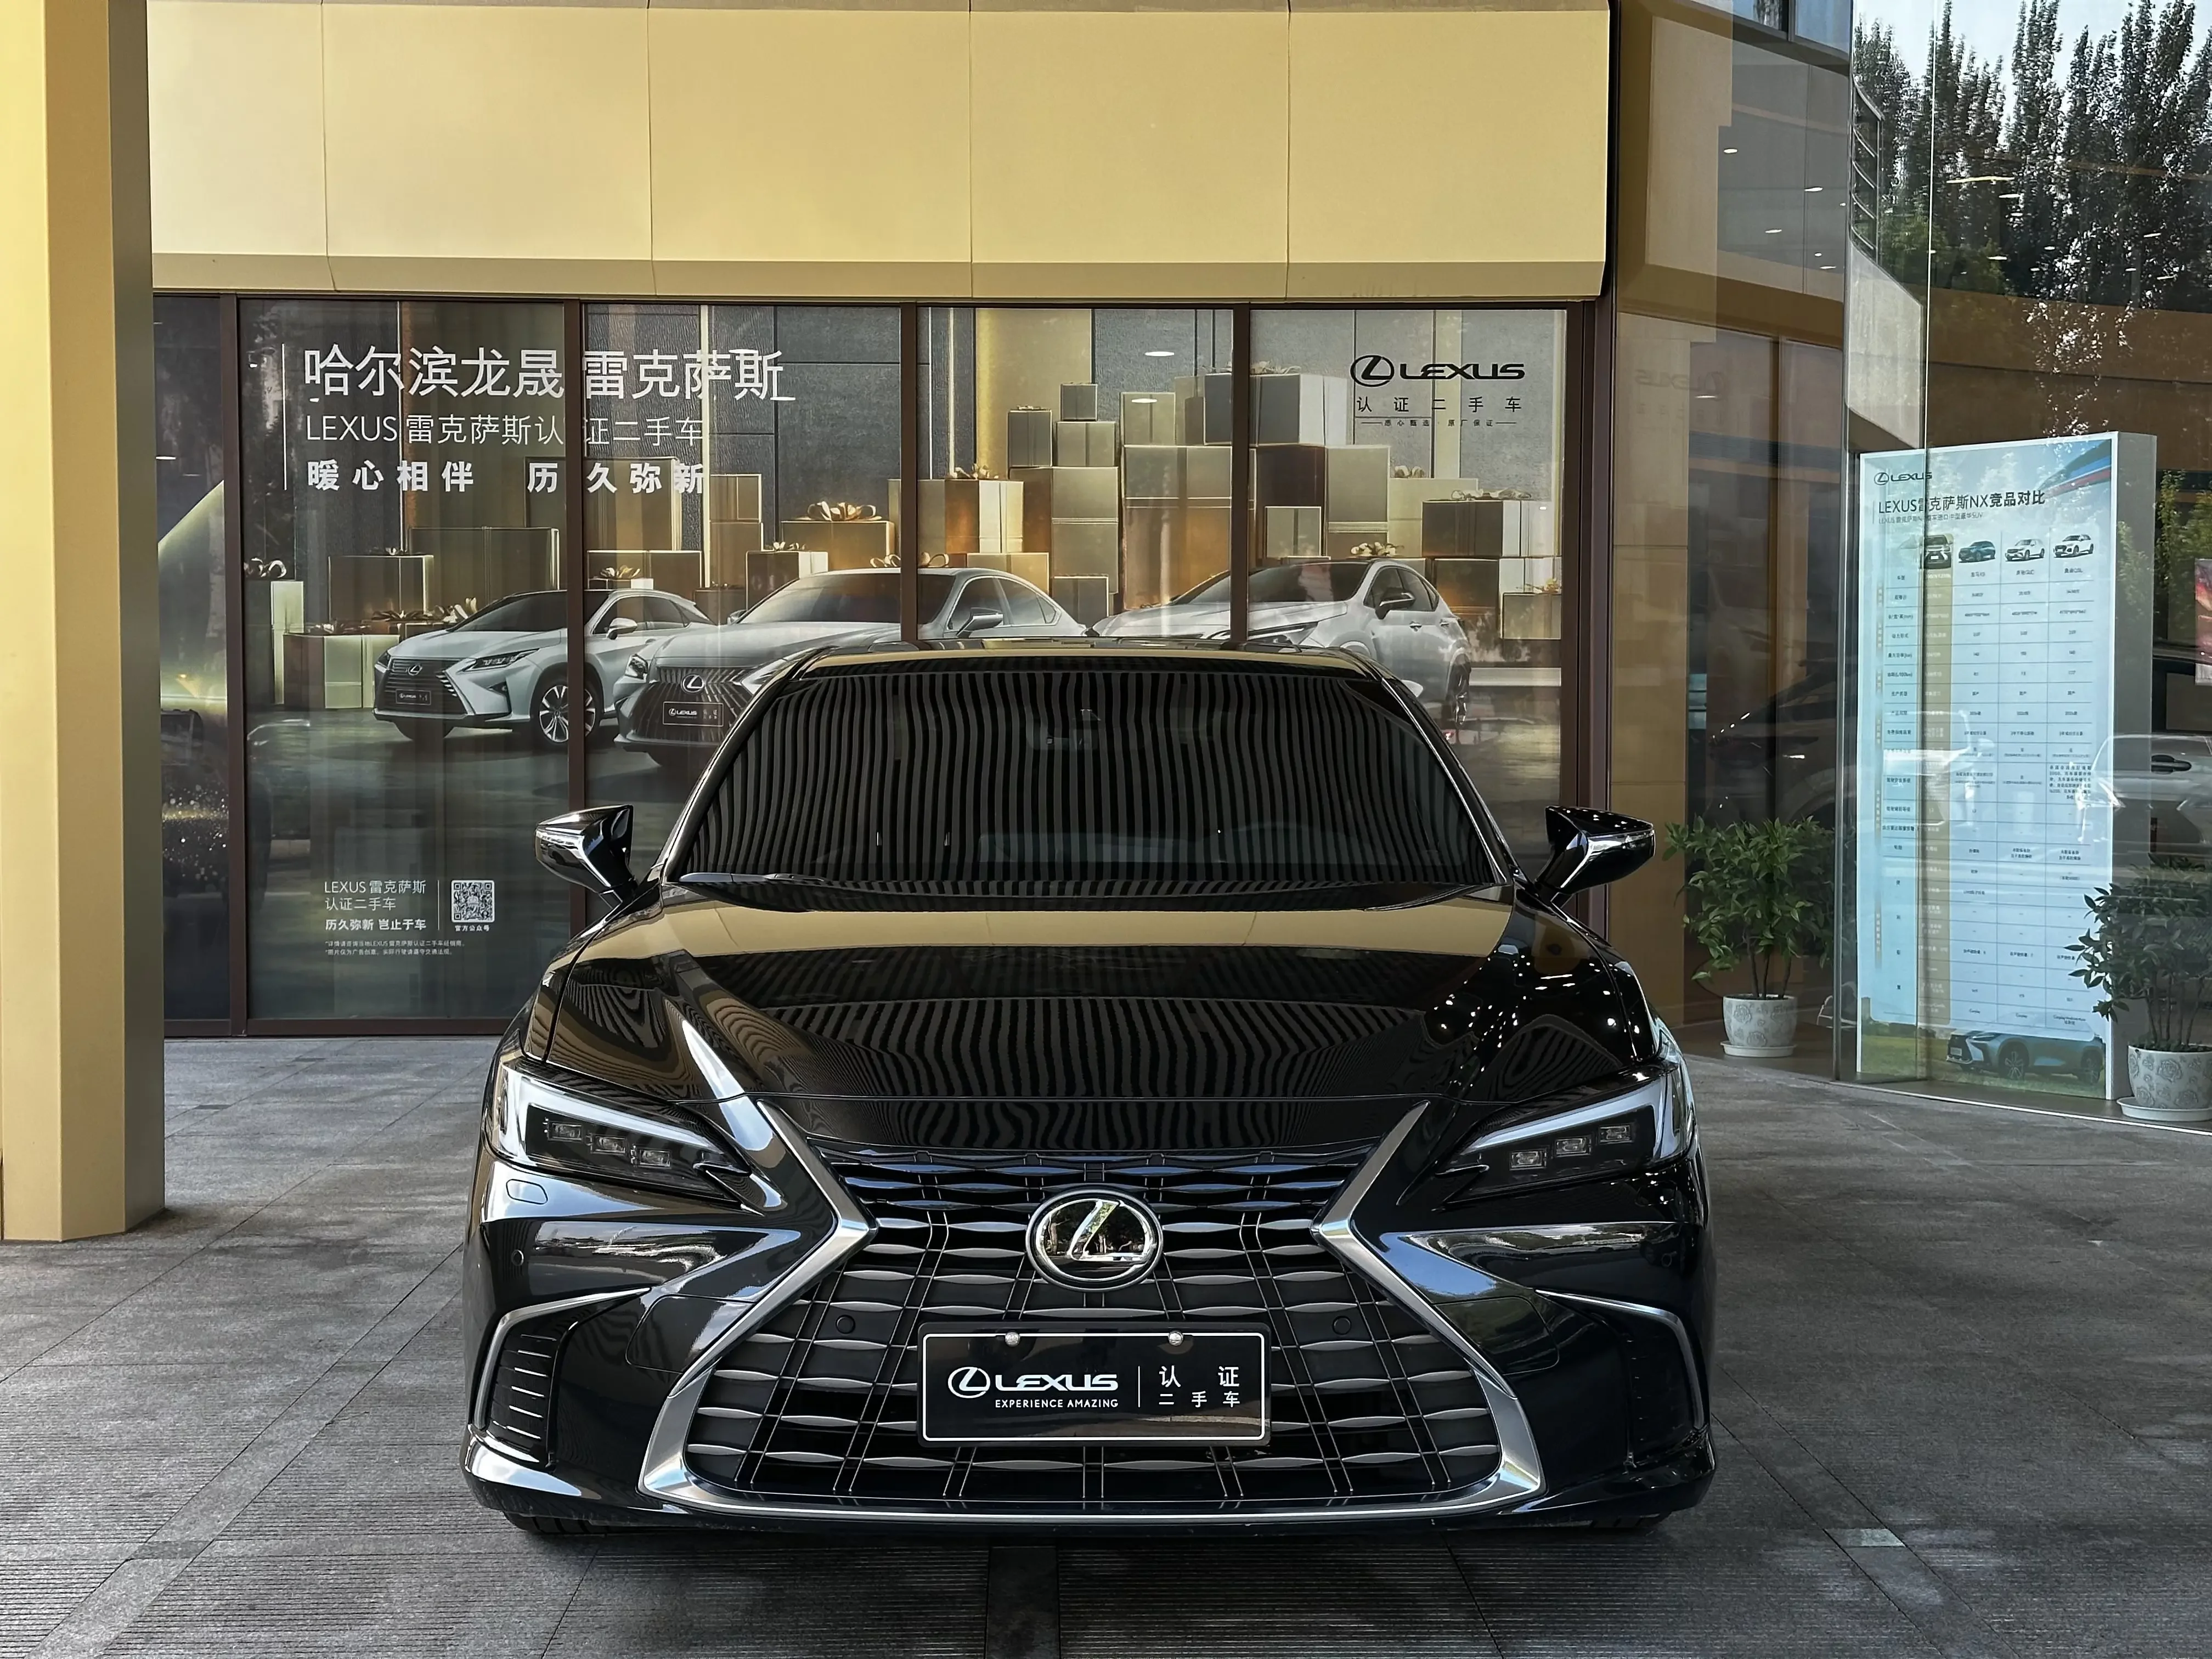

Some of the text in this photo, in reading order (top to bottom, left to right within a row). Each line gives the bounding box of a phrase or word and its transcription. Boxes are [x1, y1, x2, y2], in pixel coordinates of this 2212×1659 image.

[1400, 363, 1525, 380] LEXUS
[1357, 396, 1522, 412] 认证二手车
[307, 416, 396, 441] LEXUS
[308, 460, 704, 494] 暖心相伴 历久弥新
[1891, 472, 1932, 482] LEXUS
[324, 879, 426, 894] LEXUS 雷克萨斯
[325, 897, 396, 911] 认证二手车
[325, 918, 427, 932] 历久弥新 岂止于车
[995, 1374, 1119, 1391] LEXUS
[1159, 1365, 1240, 1387] 认证
[995, 1399, 1119, 1408] EXPERIENCE AMAZING
[1159, 1391, 1240, 1408] 二手车
